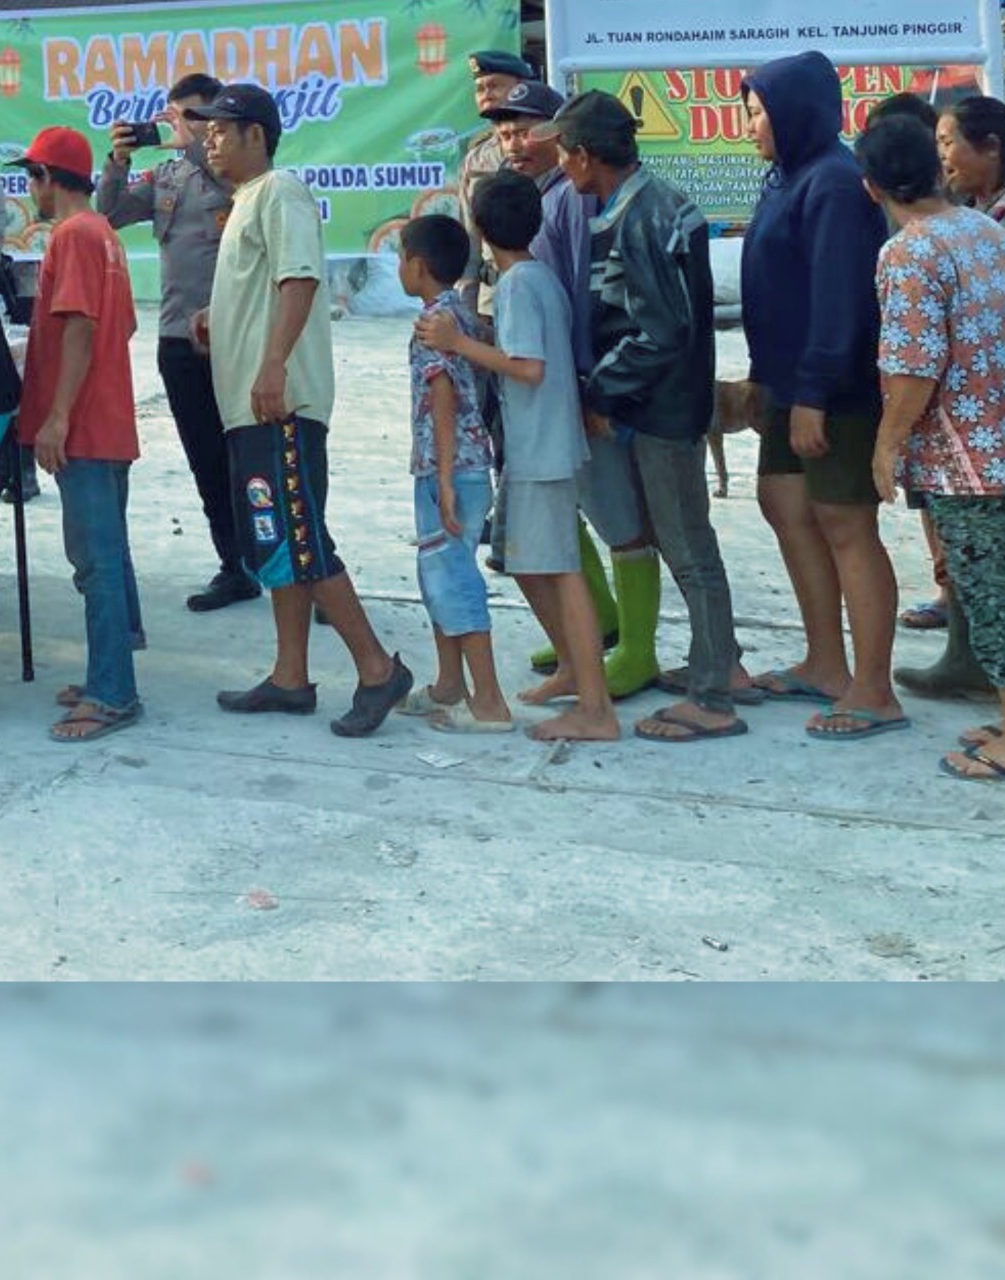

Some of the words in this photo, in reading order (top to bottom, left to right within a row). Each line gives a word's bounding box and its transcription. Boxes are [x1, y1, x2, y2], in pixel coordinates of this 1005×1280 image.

[585, 32, 604, 45] JL.
[606, 31, 643, 44] TUAN
[646, 29, 727, 43] RONDAHAIM
[729, 27, 790, 40] SARAGIH
[797, 25, 829, 39] KEL.
[831, 23, 899, 38] TANJUNG
[902, 21, 964, 35] PINGGIR
[46, 19, 385, 98] RAMADHAN
[304, 166, 369, 188] POLDA
[374, 164, 443, 187] SUMUT
